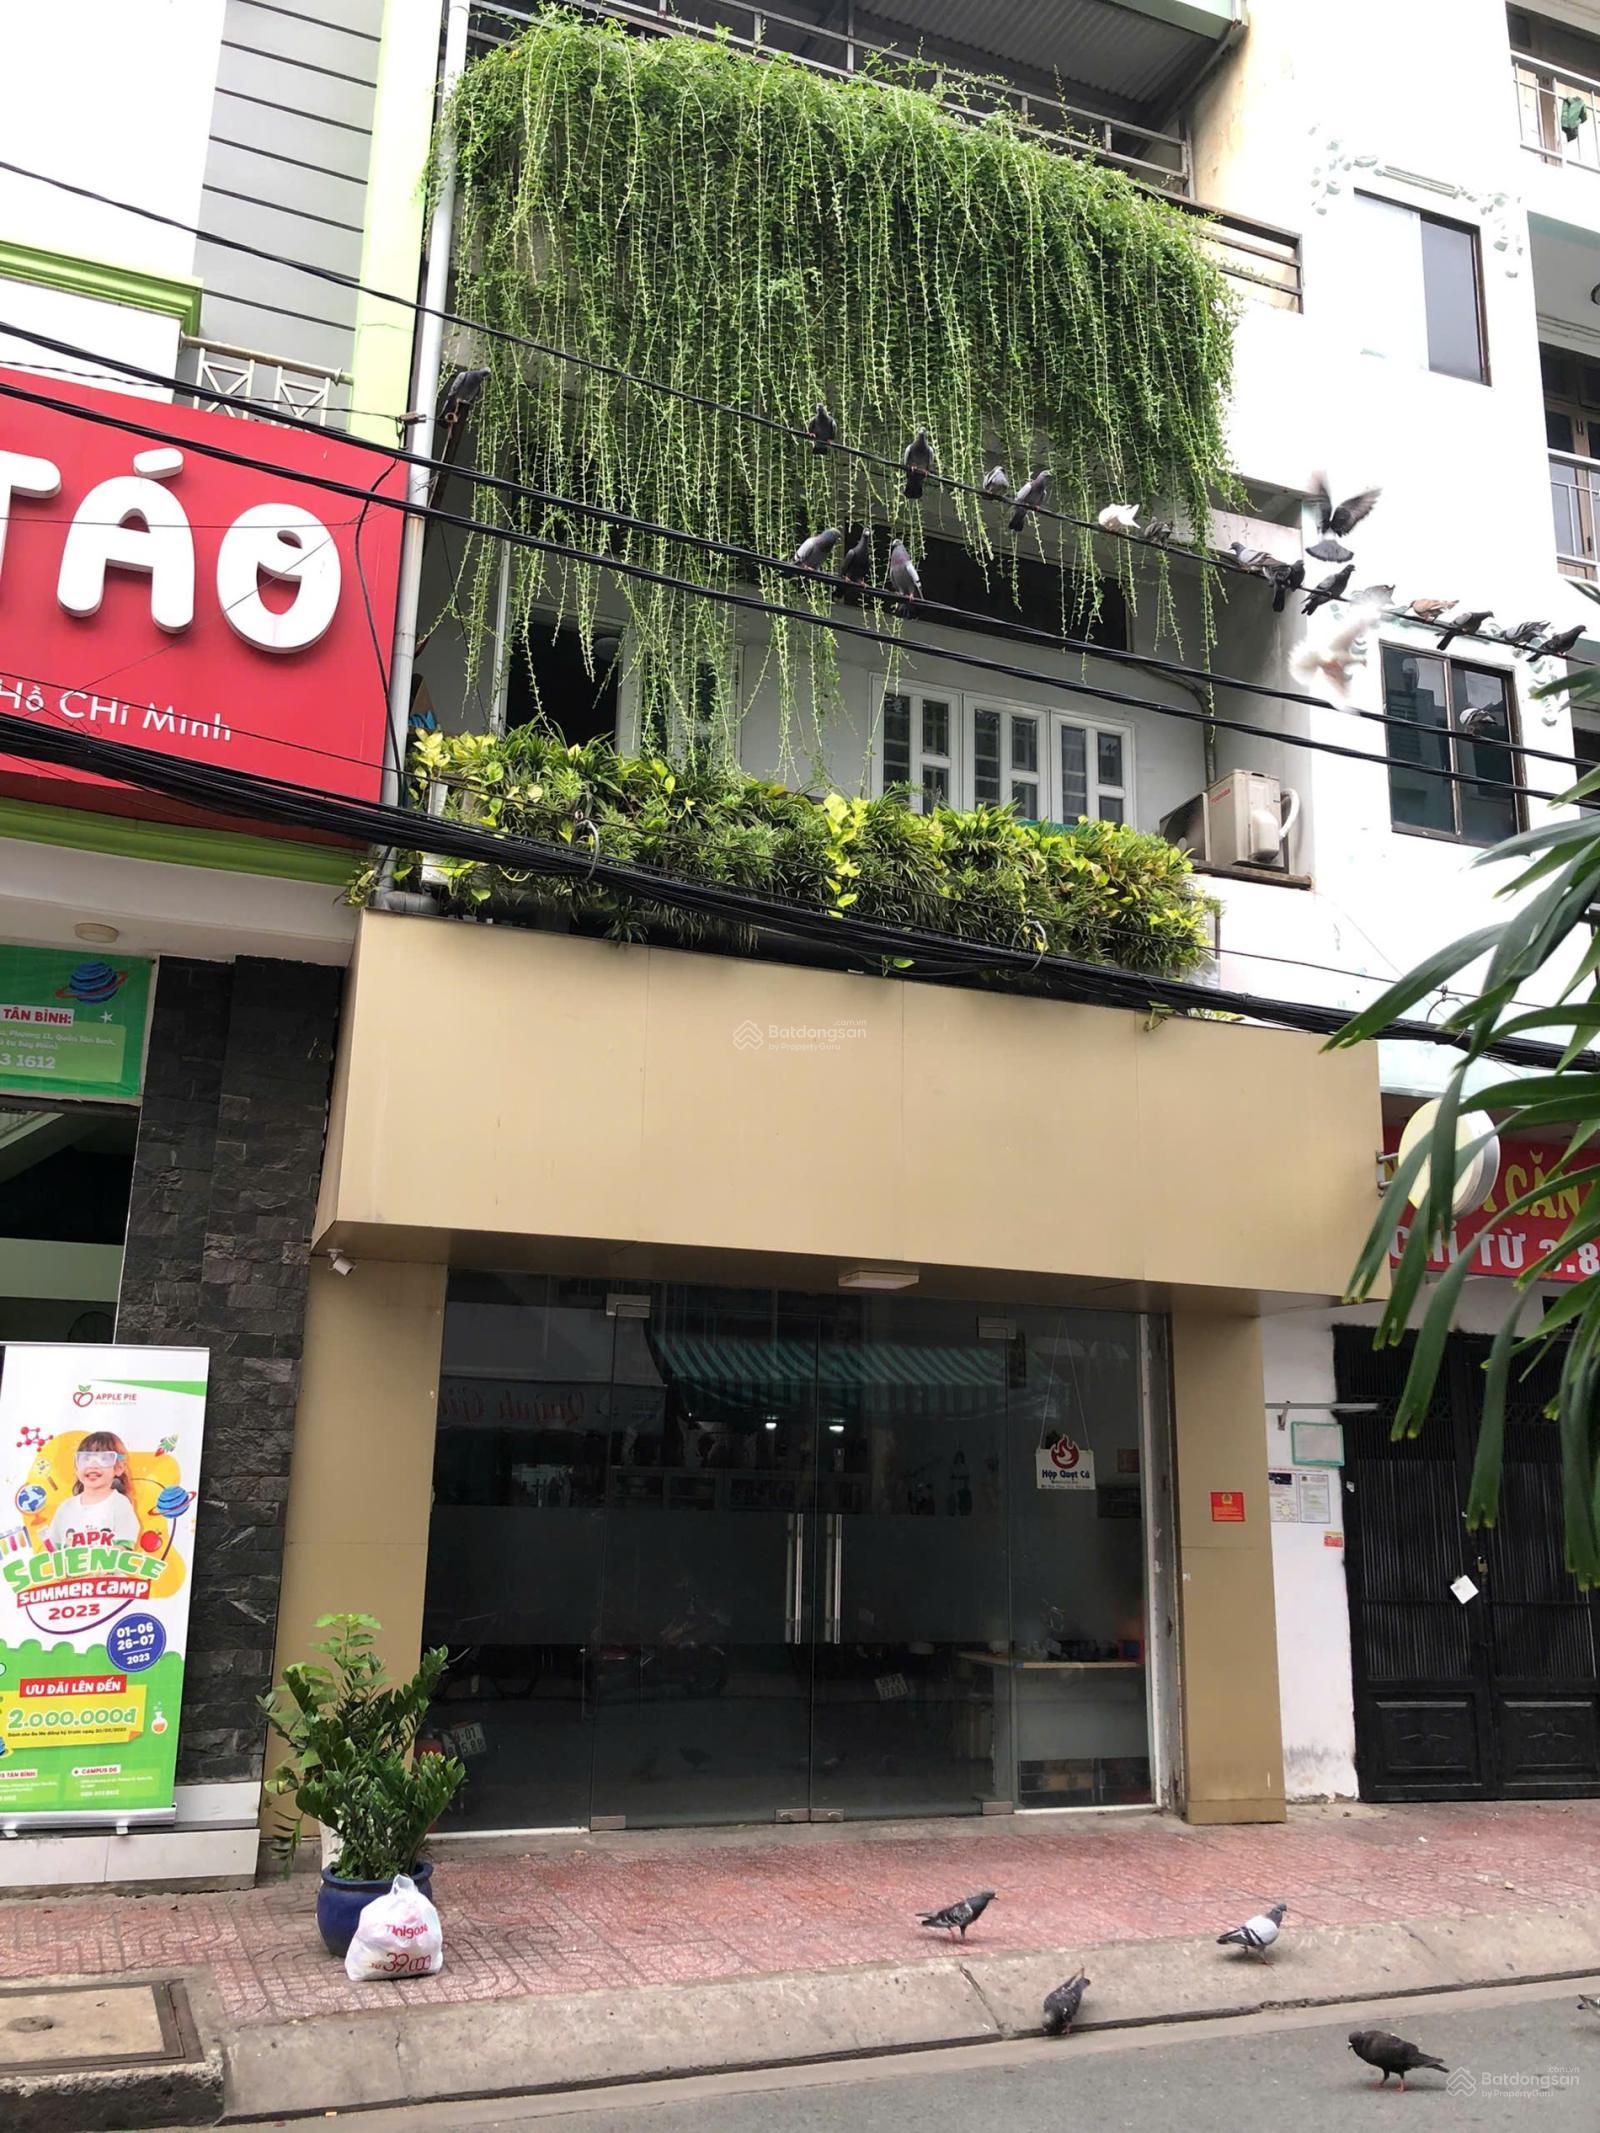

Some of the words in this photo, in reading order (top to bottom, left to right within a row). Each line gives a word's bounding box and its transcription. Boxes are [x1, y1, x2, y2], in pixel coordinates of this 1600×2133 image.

[0, 679, 45, 712] Hồ
[142, 702, 232, 741] Minh
[4, 1007, 31, 1021] TÂN
[34, 1009, 72, 1024] BÌNH:
[16, 1054, 56, 1069] 1612
[1474, 1228, 1527, 1269] TỪ
[95, 1393, 122, 1401] APPLE
[123, 1393, 137, 1401] PIE
[72, 1531, 115, 1547] APK
[3, 1547, 166, 1593] SCIENCE
[48, 1603, 100, 1620] 2023
[116, 1622, 154, 1639] 01-06
[117, 1634, 155, 1651] 26-07
[127, 1653, 150, 1665] 2023
[72, 1679, 95, 1693] LÊN
[97, 1676, 121, 1692] ĐẾN
[8, 1707, 137, 1730] 2.000.000đ
